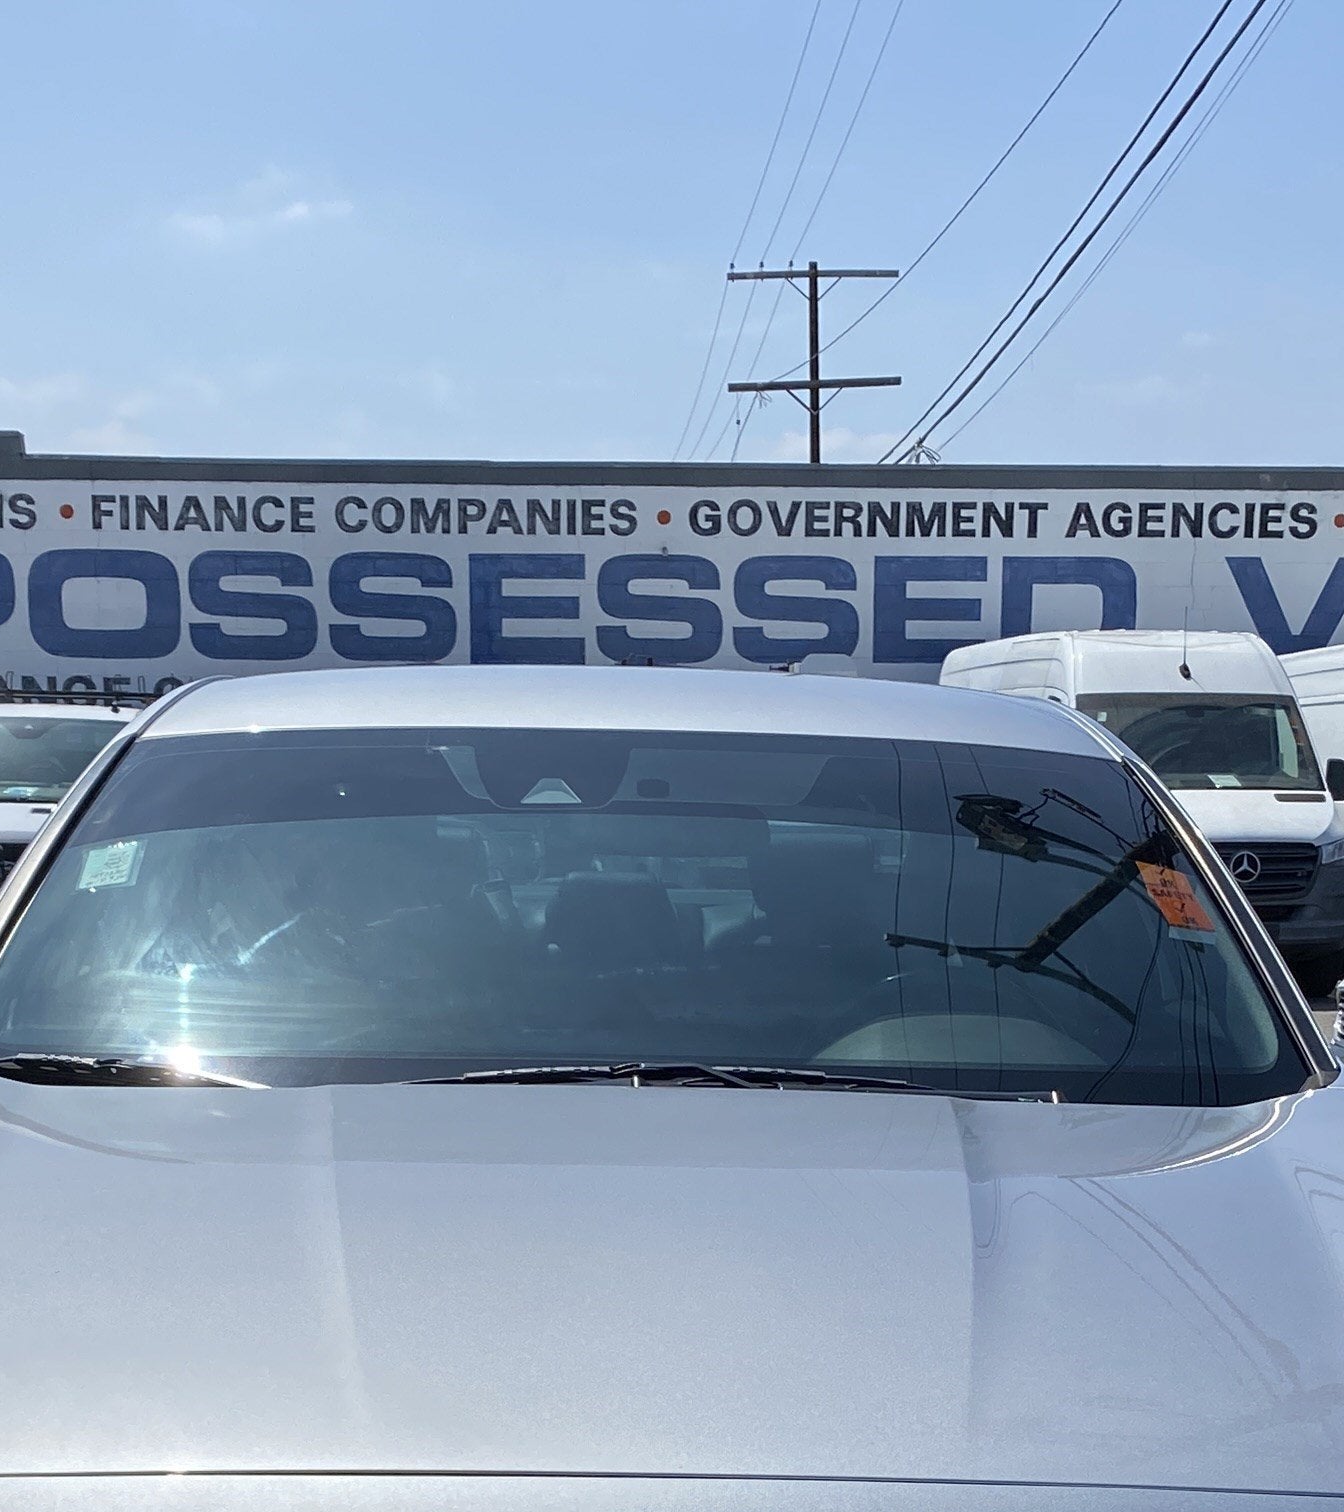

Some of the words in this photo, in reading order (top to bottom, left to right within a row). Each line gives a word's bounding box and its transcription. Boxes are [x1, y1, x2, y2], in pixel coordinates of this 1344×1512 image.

[91, 494, 315, 535] FINANCE
[334, 496, 638, 537] COMPANIES
[688, 499, 1048, 539] GOVERNMENT
[1065, 502, 1319, 540] AGENCIES
